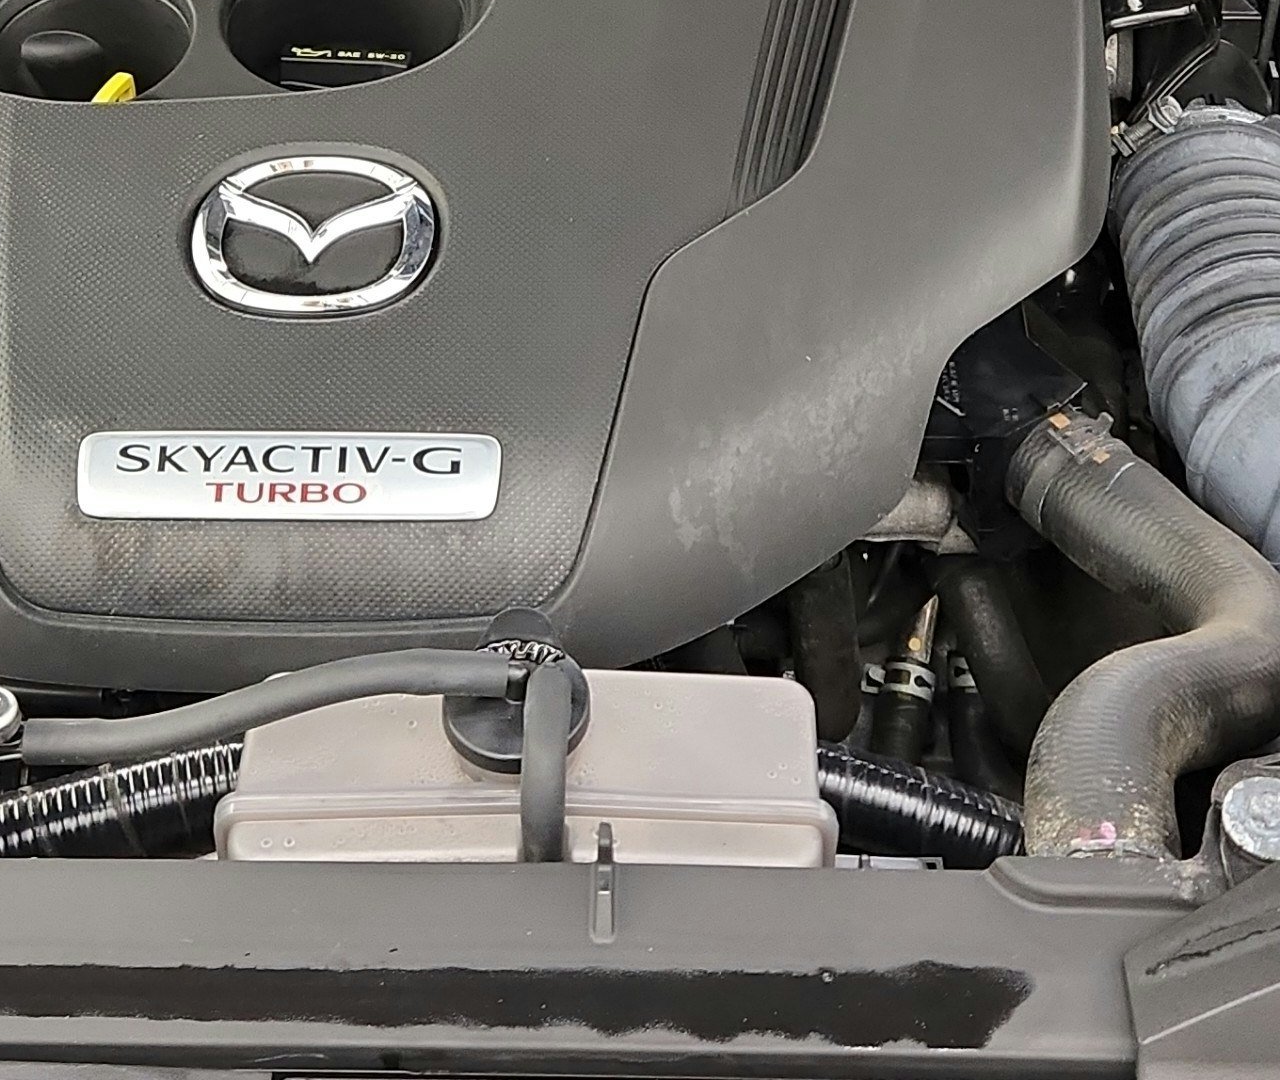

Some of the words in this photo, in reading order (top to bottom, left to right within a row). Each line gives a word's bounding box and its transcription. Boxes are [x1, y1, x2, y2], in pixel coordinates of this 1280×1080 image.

[337, 50, 361, 58] SAE
[116, 444, 462, 475] SKYACTIV-G
[205, 482, 367, 504] TURBO
